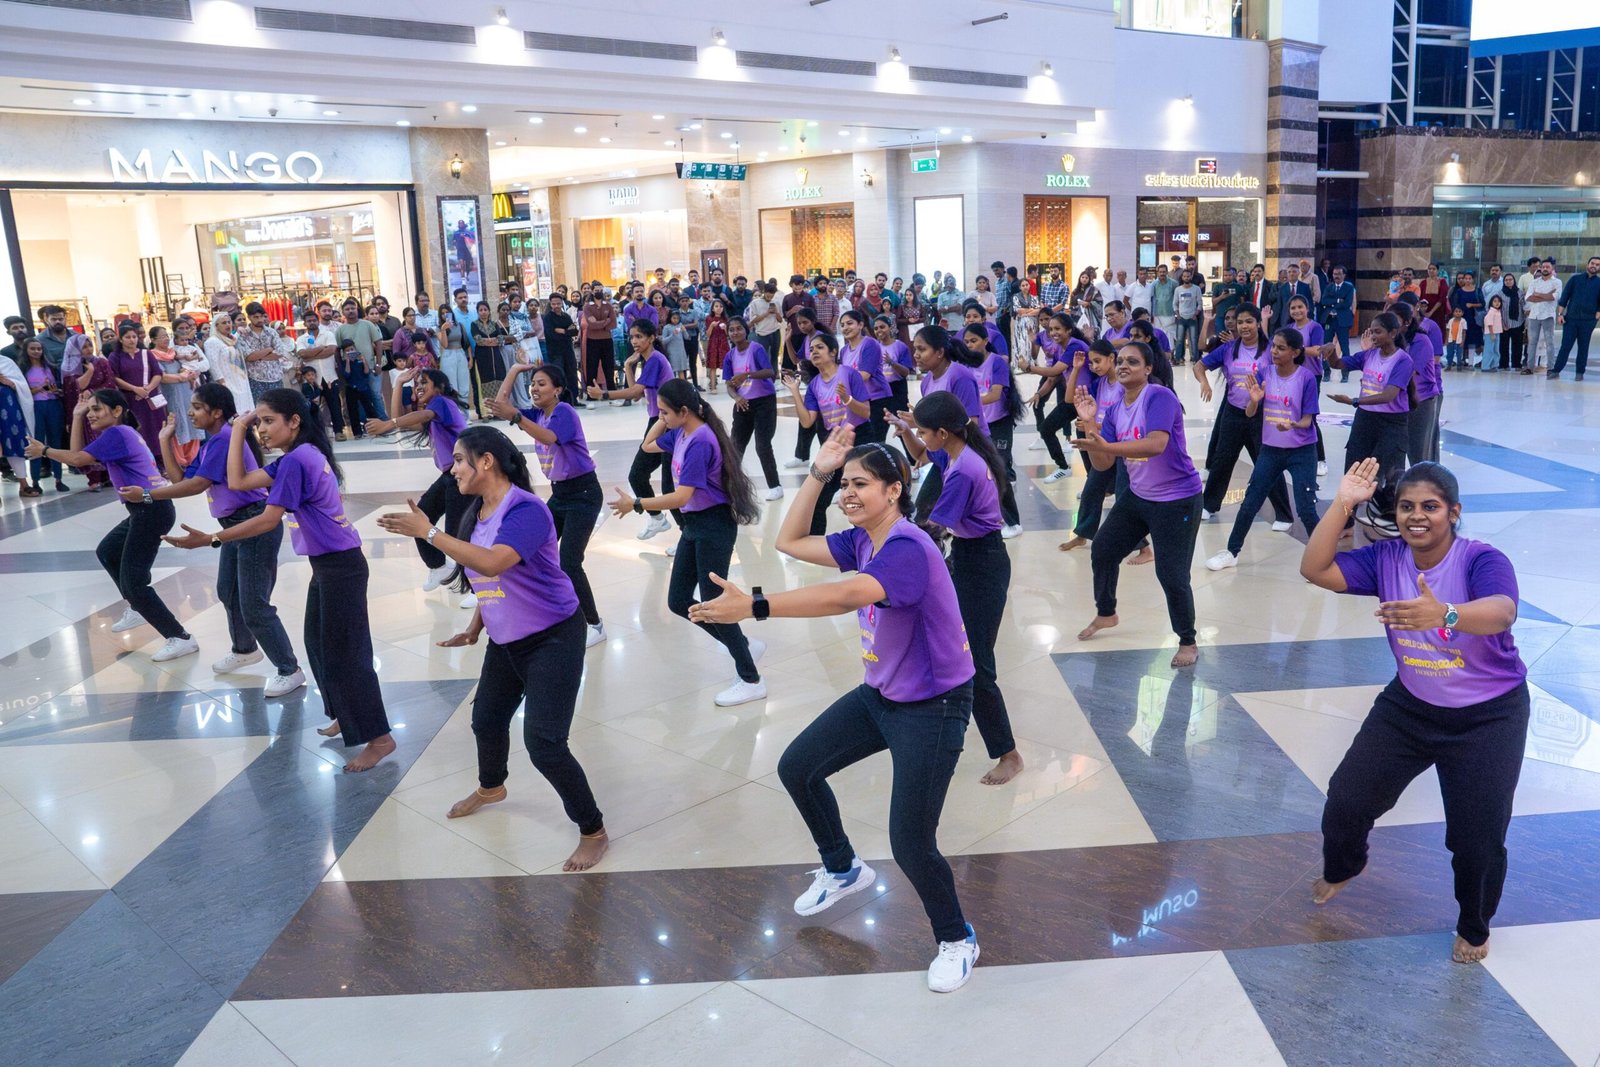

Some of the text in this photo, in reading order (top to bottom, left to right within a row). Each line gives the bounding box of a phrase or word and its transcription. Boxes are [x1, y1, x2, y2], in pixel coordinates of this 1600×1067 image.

[107, 147, 324, 184] MANGO
[1046, 174, 1091, 188] ROLEX
[784, 185, 824, 201] ROLEX
